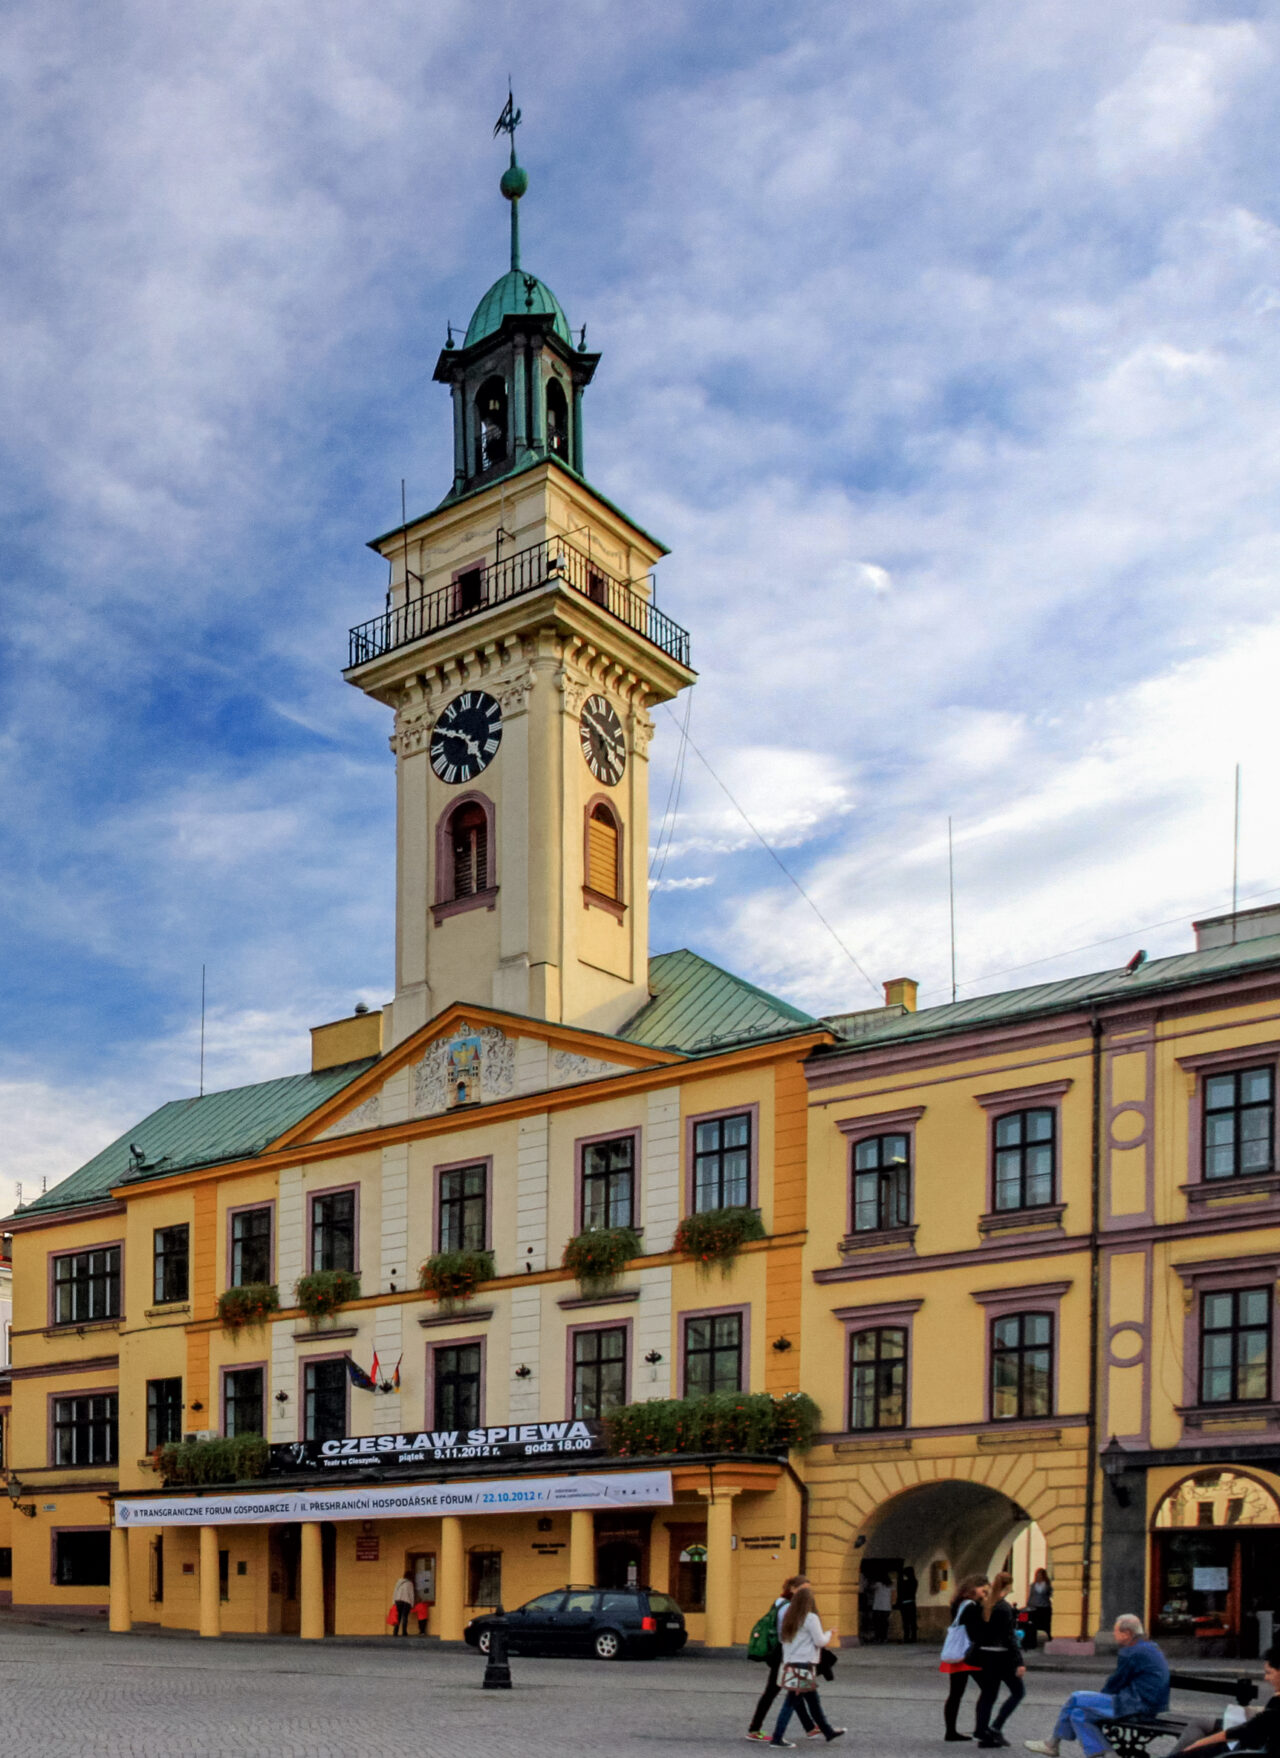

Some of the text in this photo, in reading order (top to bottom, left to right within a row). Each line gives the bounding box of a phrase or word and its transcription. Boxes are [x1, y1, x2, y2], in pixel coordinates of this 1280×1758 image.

[322, 1422, 590, 1454] CZESŁAW ŚPIEWA
[399, 1452, 424, 1462] piątek
[434, 1446, 490, 1459] 9.11.2012
[492, 1447, 500, 1455] r.
[525, 1442, 553, 1455] godz
[557, 1439, 590, 1451] 18.00
[140, 1508, 203, 1517] TRANSGRANICZNE
[205, 1506, 232, 1515] FORUM
[234, 1503, 290, 1514] GOSPODARCZE
[483, 1491, 535, 1503] 22.10.2012
